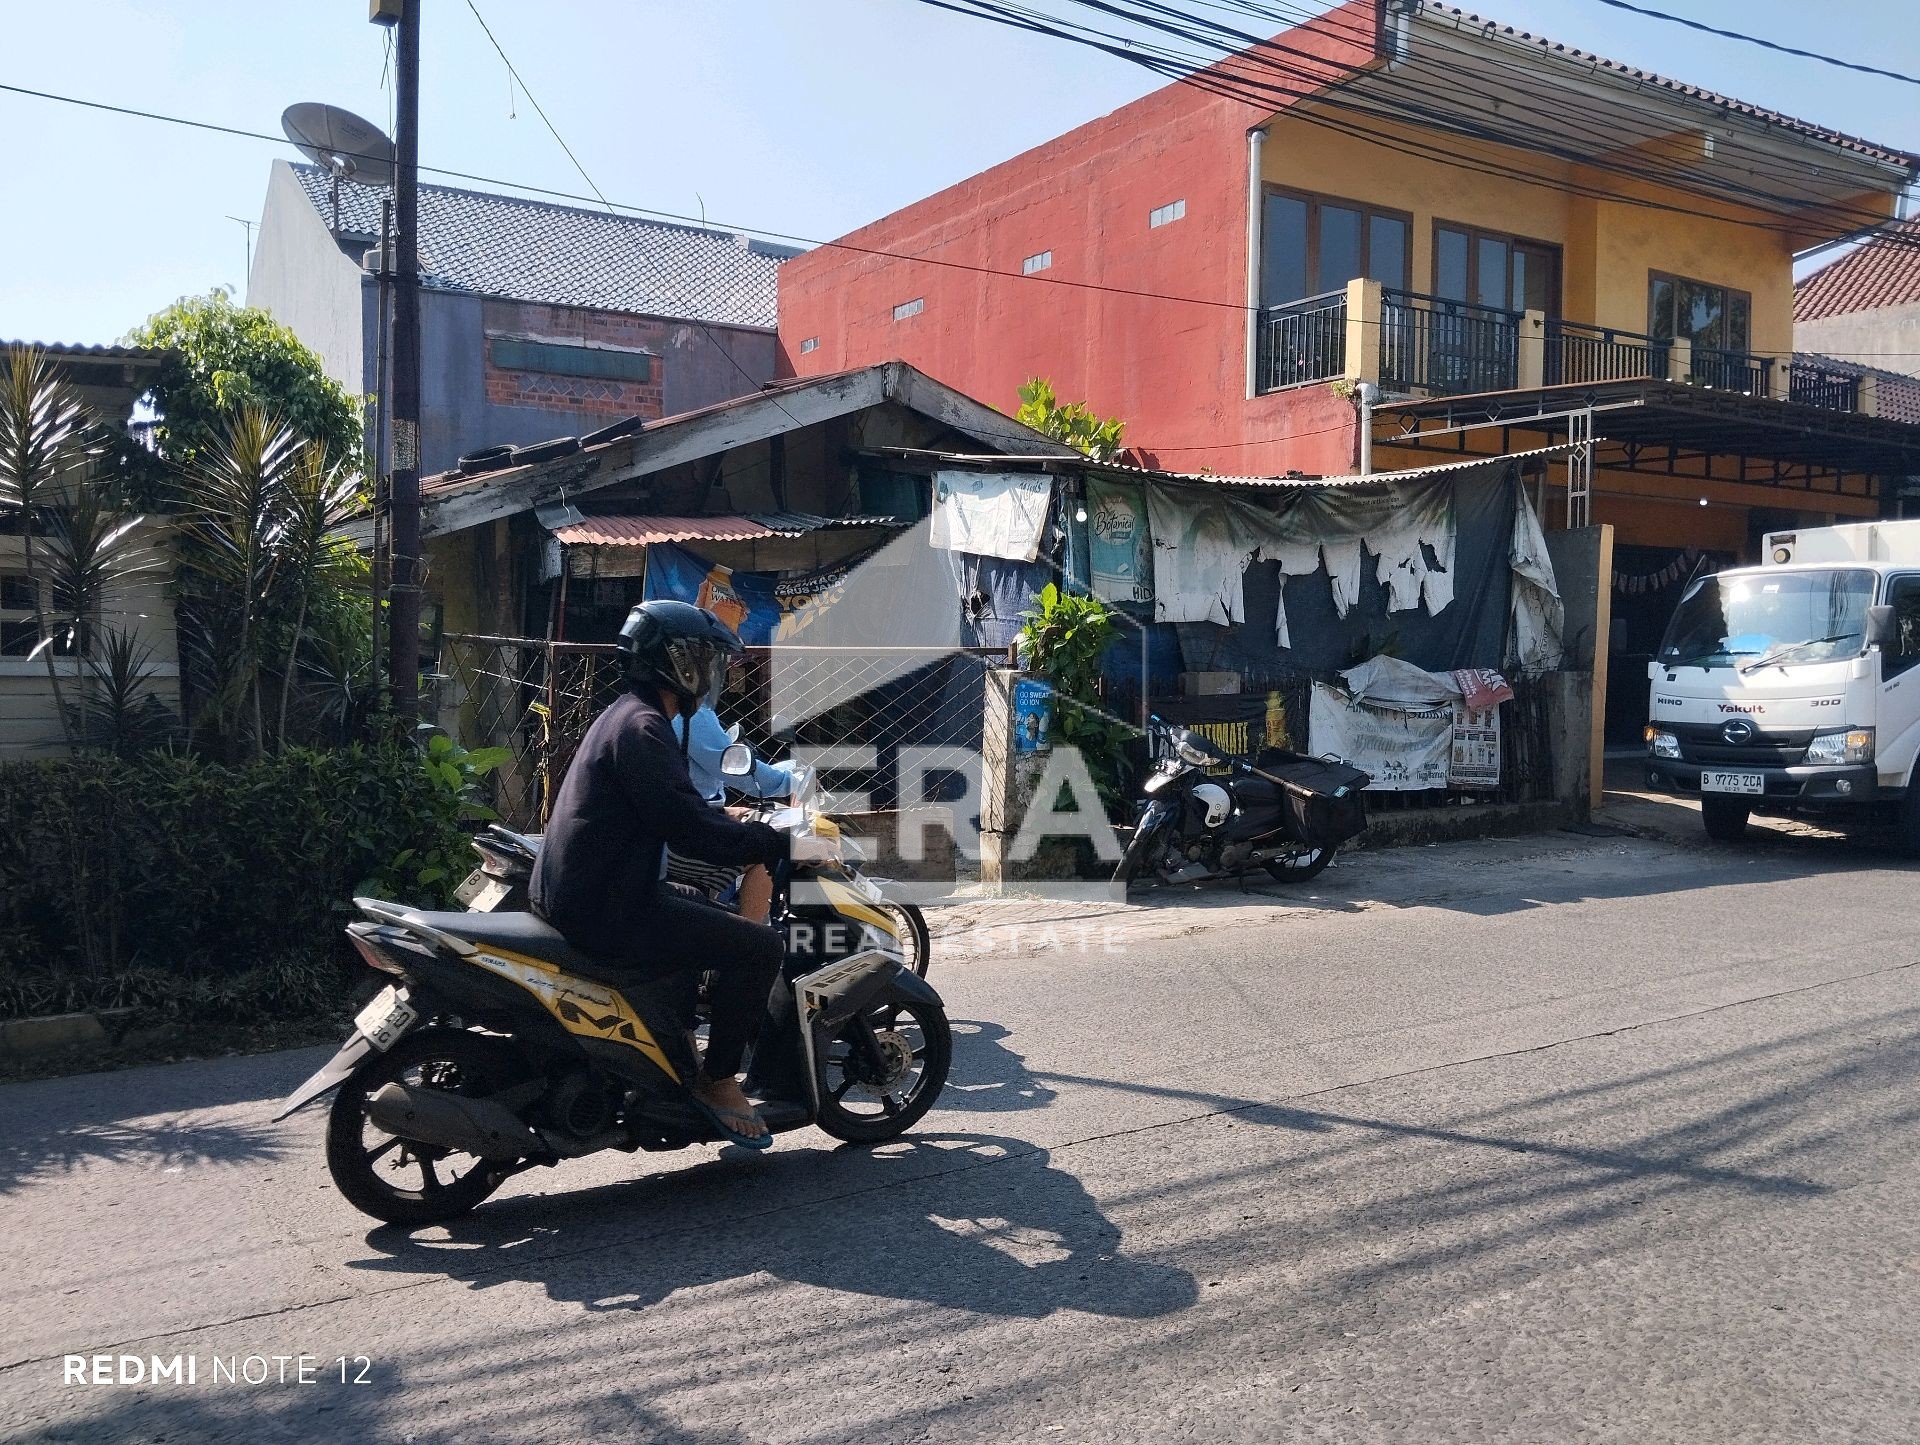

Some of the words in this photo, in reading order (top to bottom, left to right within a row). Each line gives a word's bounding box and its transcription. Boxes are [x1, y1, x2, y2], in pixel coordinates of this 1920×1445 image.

[1093, 511, 1136, 535] Botanical
[1029, 691, 1050, 699] SWEAT
[1657, 697, 1683, 706] HINO
[1810, 698, 1841, 707] 300
[1717, 703, 1766, 714] Yakult
[1703, 773, 1710, 785] B
[1715, 774, 1739, 786] 9775
[1742, 775, 1762, 787] ZCA
